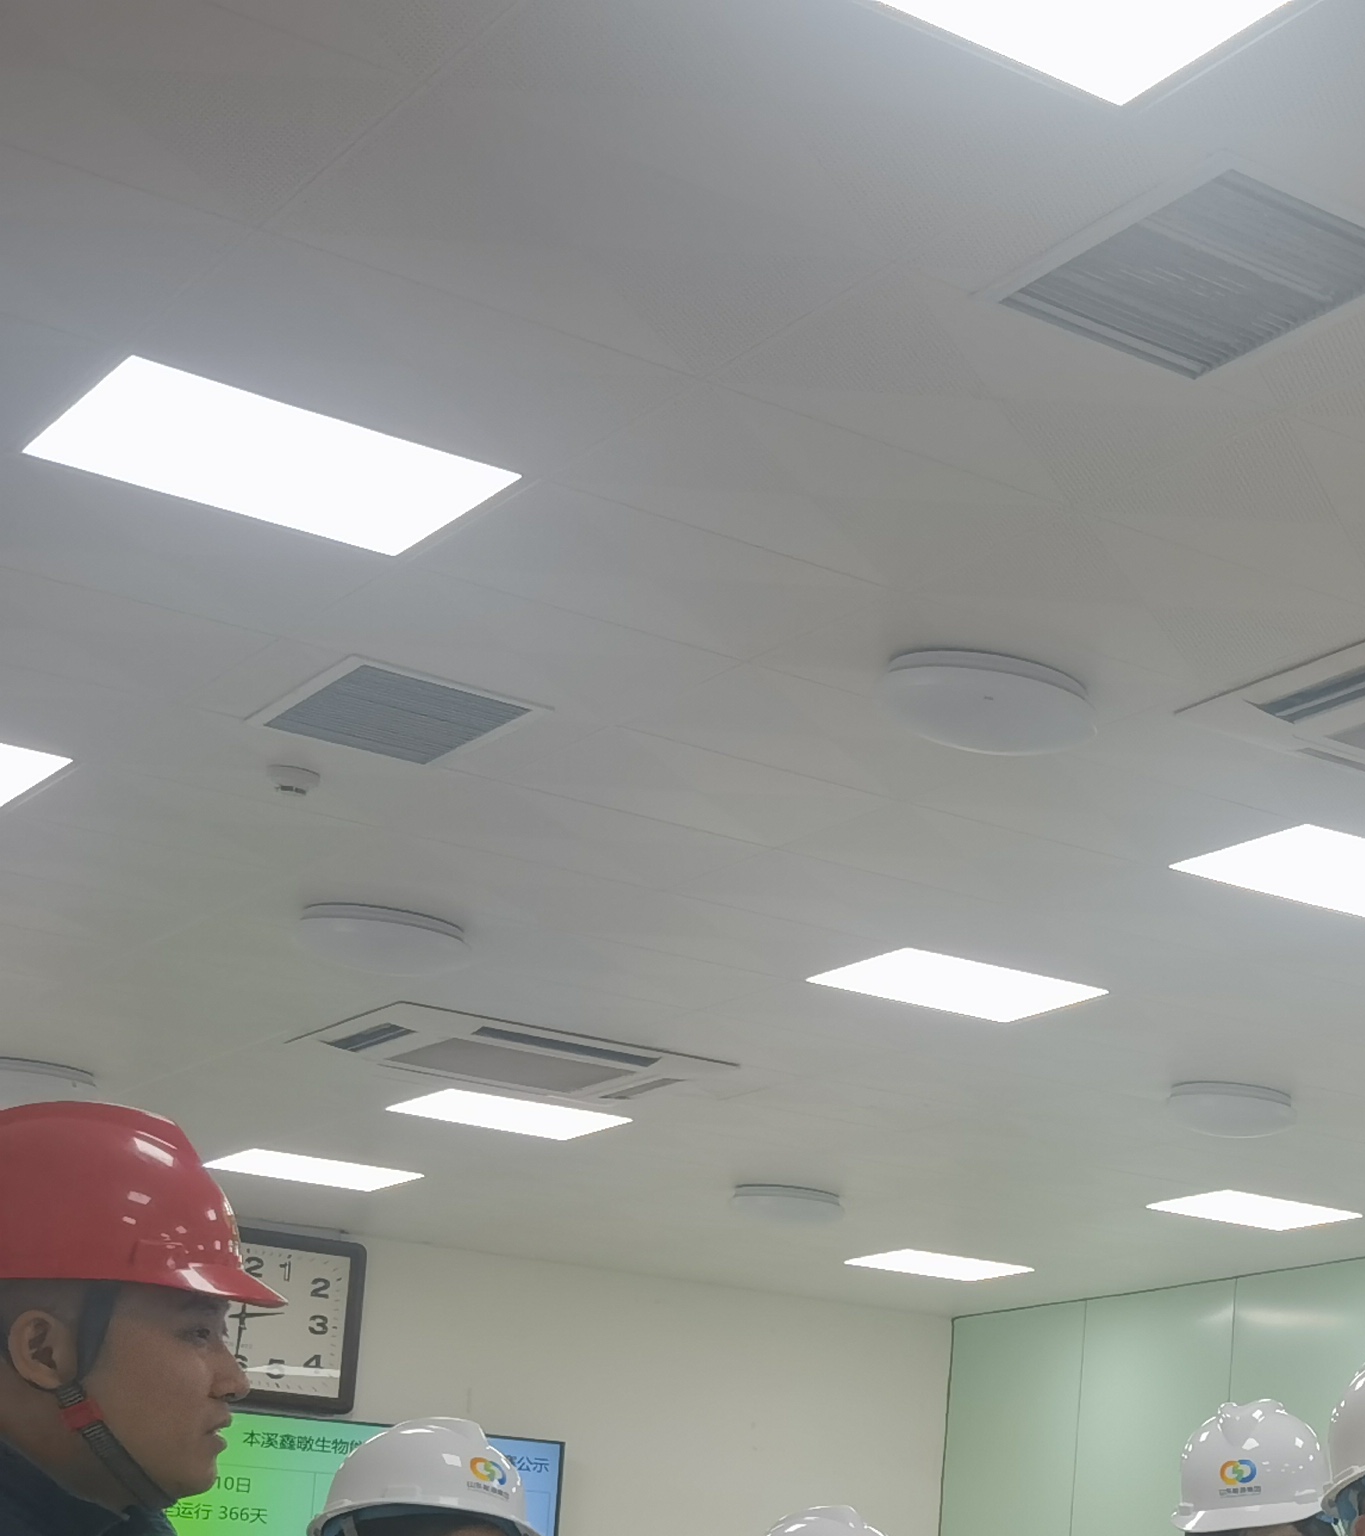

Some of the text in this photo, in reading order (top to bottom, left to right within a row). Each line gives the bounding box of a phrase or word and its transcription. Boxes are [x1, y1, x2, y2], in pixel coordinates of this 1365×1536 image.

[310, 1277, 331, 1299] 2
[308, 1314, 329, 1335] 3
[303, 1354, 325, 1372] 4
[218, 1505, 268, 1525] 366天
